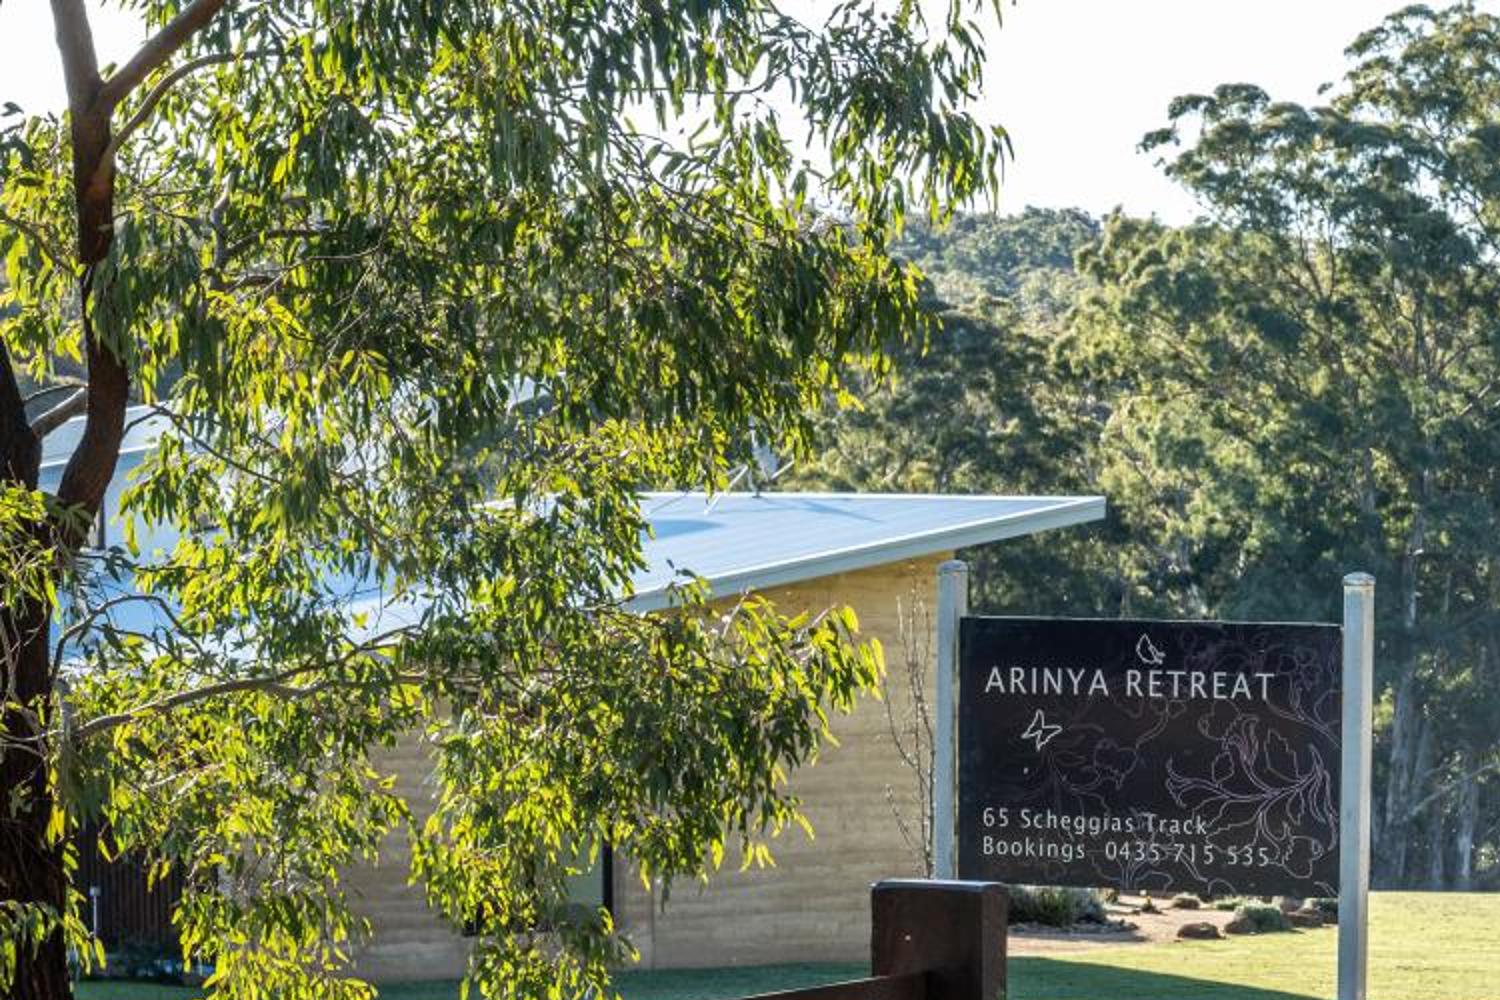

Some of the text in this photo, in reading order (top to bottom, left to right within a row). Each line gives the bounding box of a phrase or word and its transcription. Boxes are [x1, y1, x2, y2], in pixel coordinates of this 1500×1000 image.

[985, 666, 1275, 700] ARINYA RETREAT
[983, 807, 1207, 835] 65 Scheggias Track
[983, 836, 1269, 867] Bookings 0435 715 535
